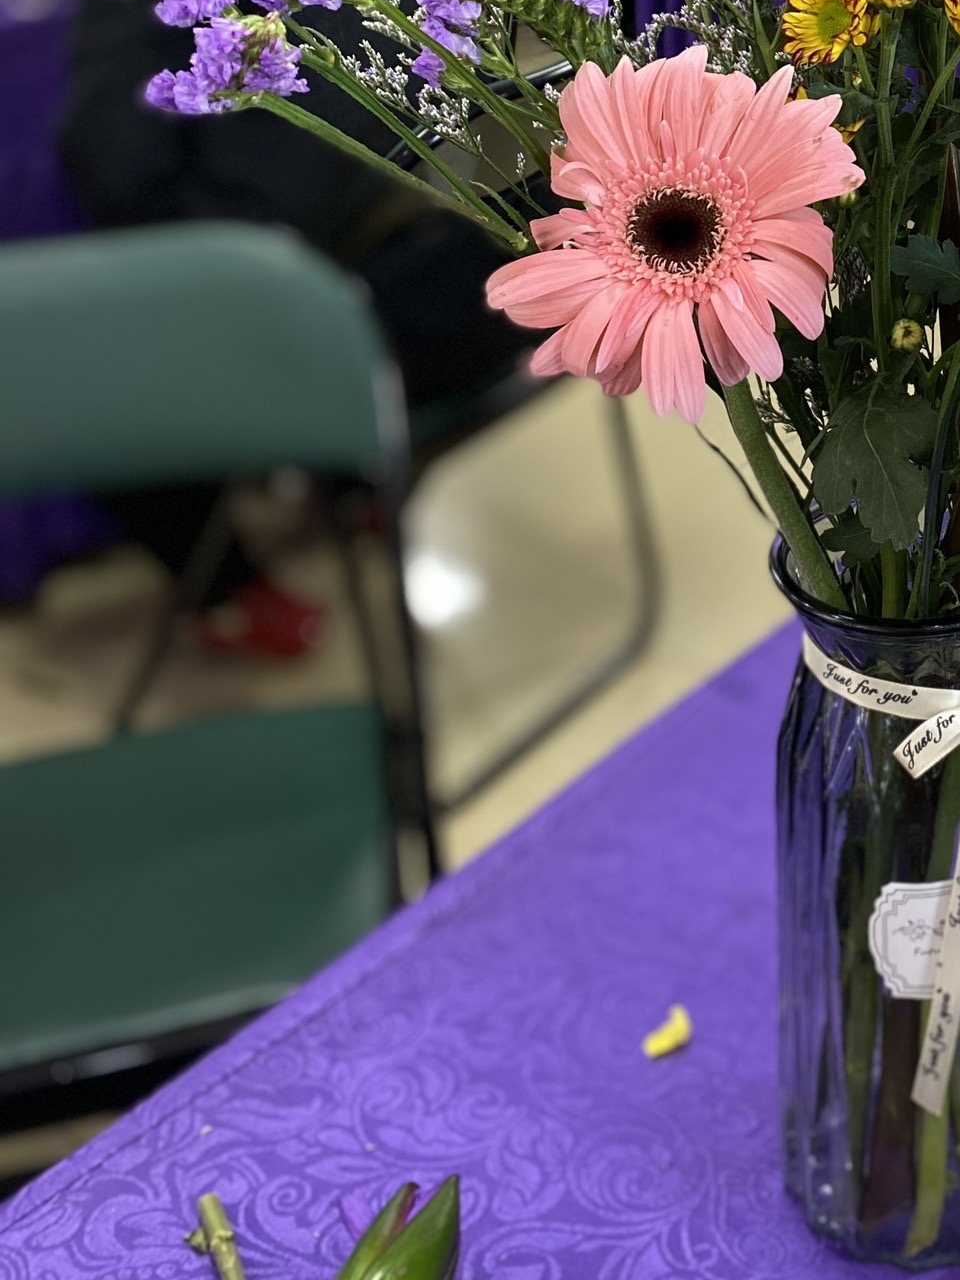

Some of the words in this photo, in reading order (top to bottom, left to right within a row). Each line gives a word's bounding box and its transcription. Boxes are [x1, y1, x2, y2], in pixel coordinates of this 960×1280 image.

[823, 663, 852, 687] Just
[849, 680, 878, 695] for
[877, 690, 913, 704] you
[902, 730, 933, 769] Just
[933, 714, 956, 743] for
[929, 1024, 947, 1052] for
